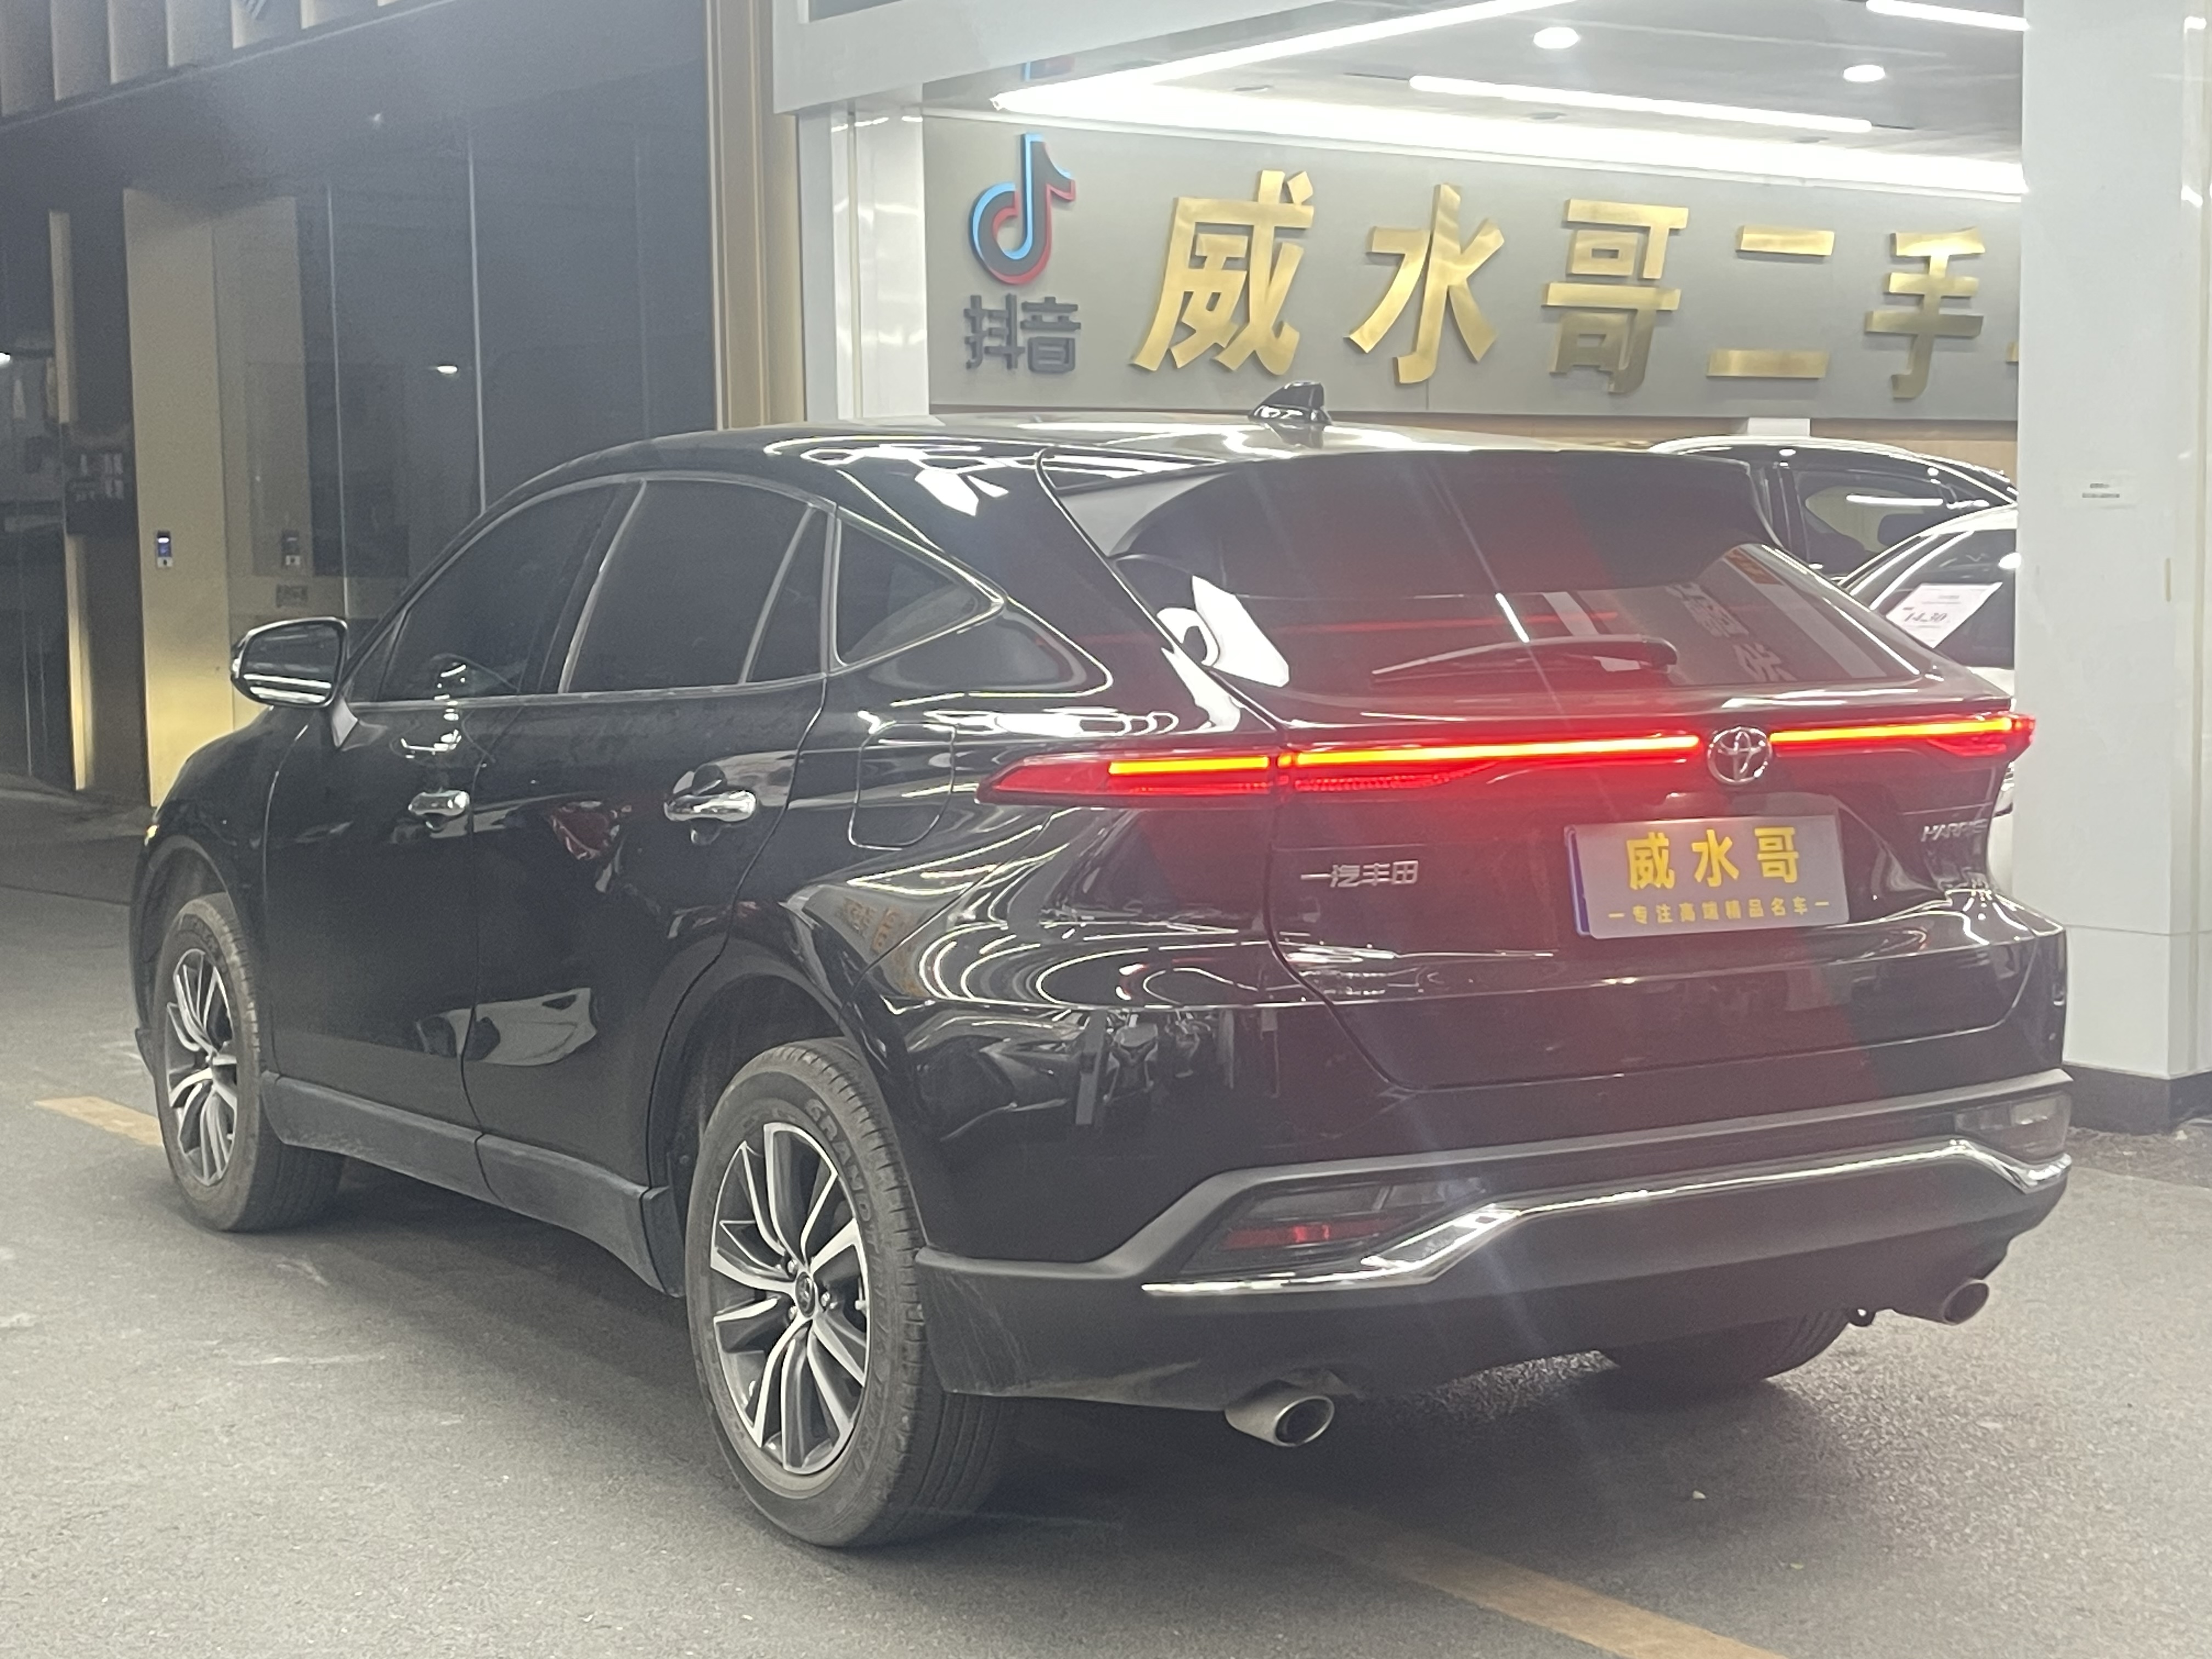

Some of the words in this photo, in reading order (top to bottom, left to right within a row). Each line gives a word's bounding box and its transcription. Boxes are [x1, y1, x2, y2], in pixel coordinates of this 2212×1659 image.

[1131, 169, 2018, 398] 威水哥二手
[964, 294, 1080, 373] 抖音
[1300, 860, 1419, 888] 一汽丰田
[1626, 827, 1799, 890] 威水哥
